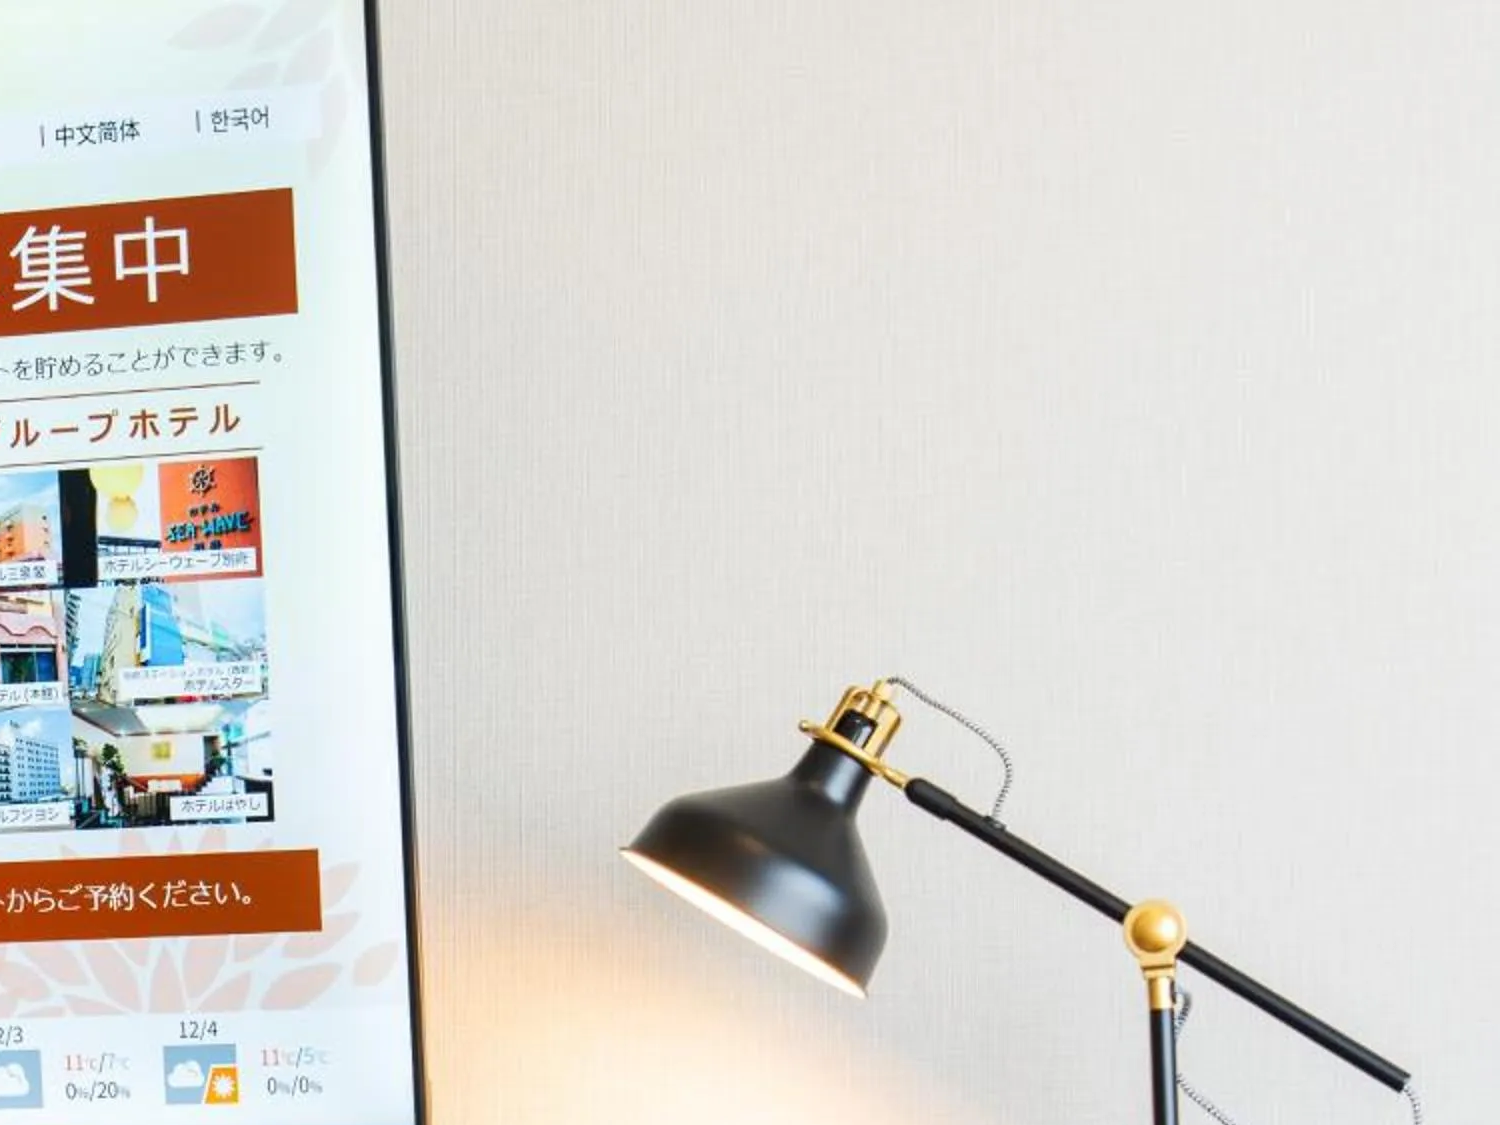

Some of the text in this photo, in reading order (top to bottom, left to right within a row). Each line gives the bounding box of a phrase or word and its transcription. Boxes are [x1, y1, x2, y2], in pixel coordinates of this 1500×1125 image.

[54, 117, 141, 146] 中文简体
[210, 105, 271, 134] 한국어
[179, 1020, 218, 1041] 12/4
